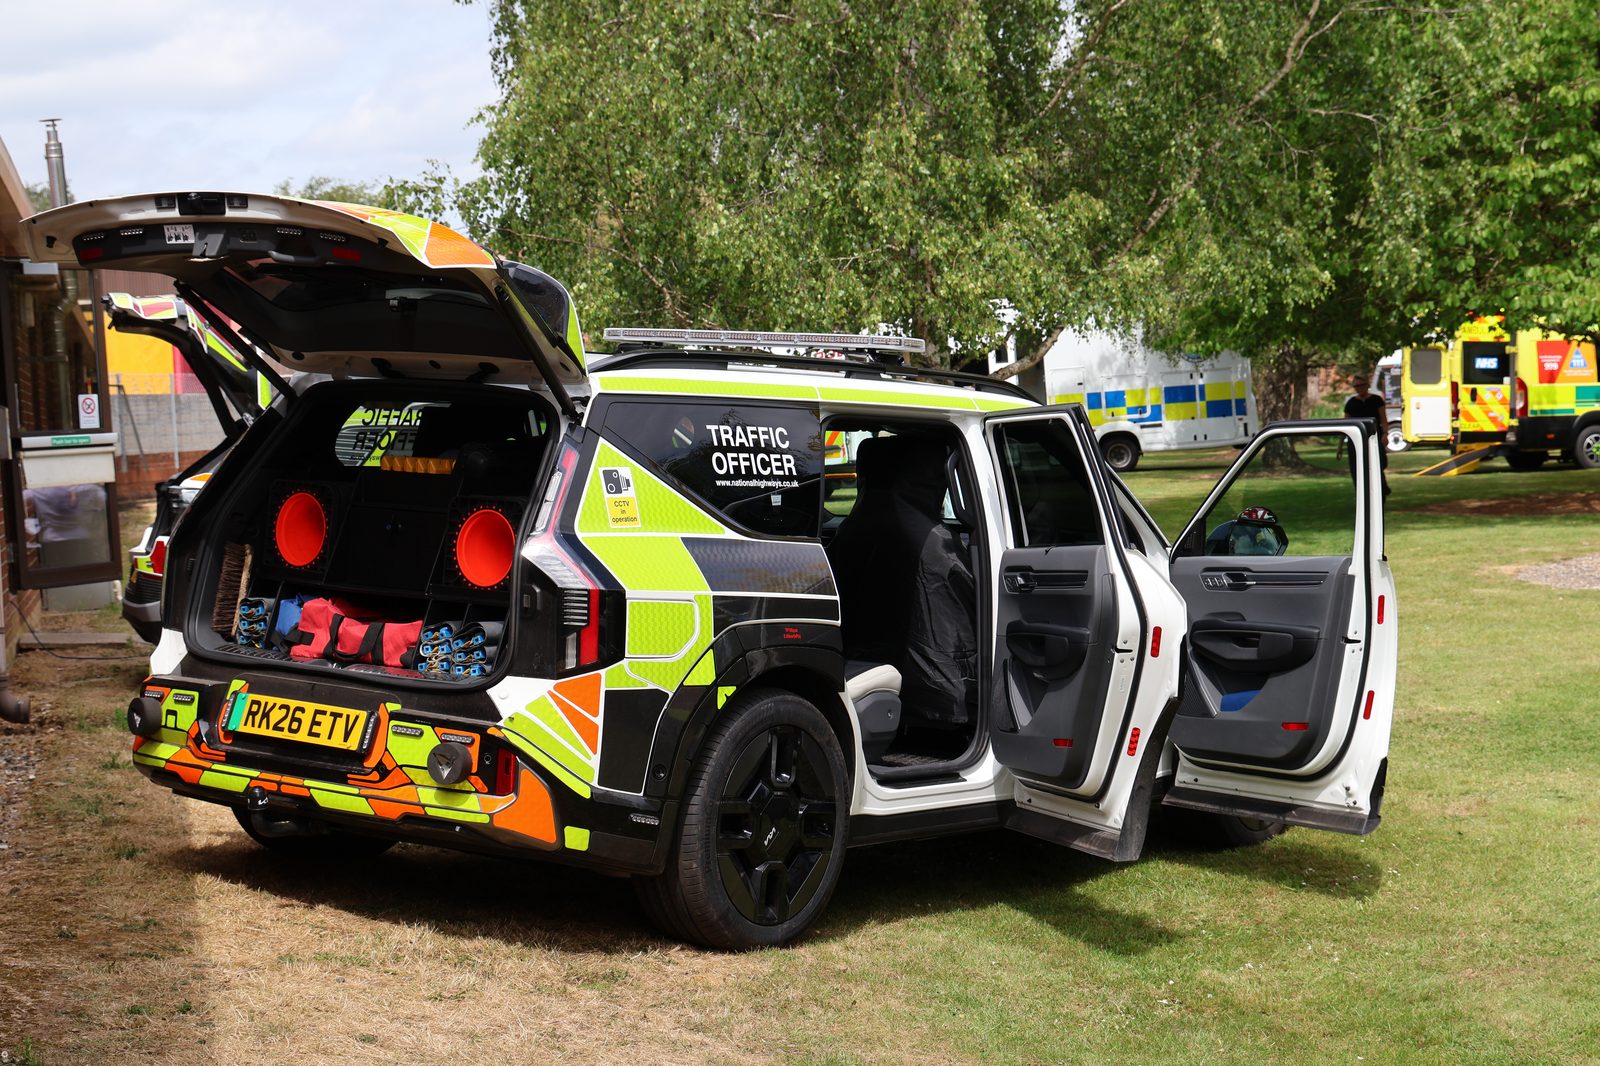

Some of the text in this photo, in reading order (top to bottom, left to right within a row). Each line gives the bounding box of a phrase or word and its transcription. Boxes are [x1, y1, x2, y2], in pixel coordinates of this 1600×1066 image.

[1475, 358, 1498, 369] NHS
[706, 425, 790, 449] TRAFFIC
[711, 452, 797, 476] OFFICER
[715, 479, 799, 489] www.nationalhighways.co.uk
[613, 500, 630, 508] CCTV
[243, 699, 360, 743] RK26 ETV
